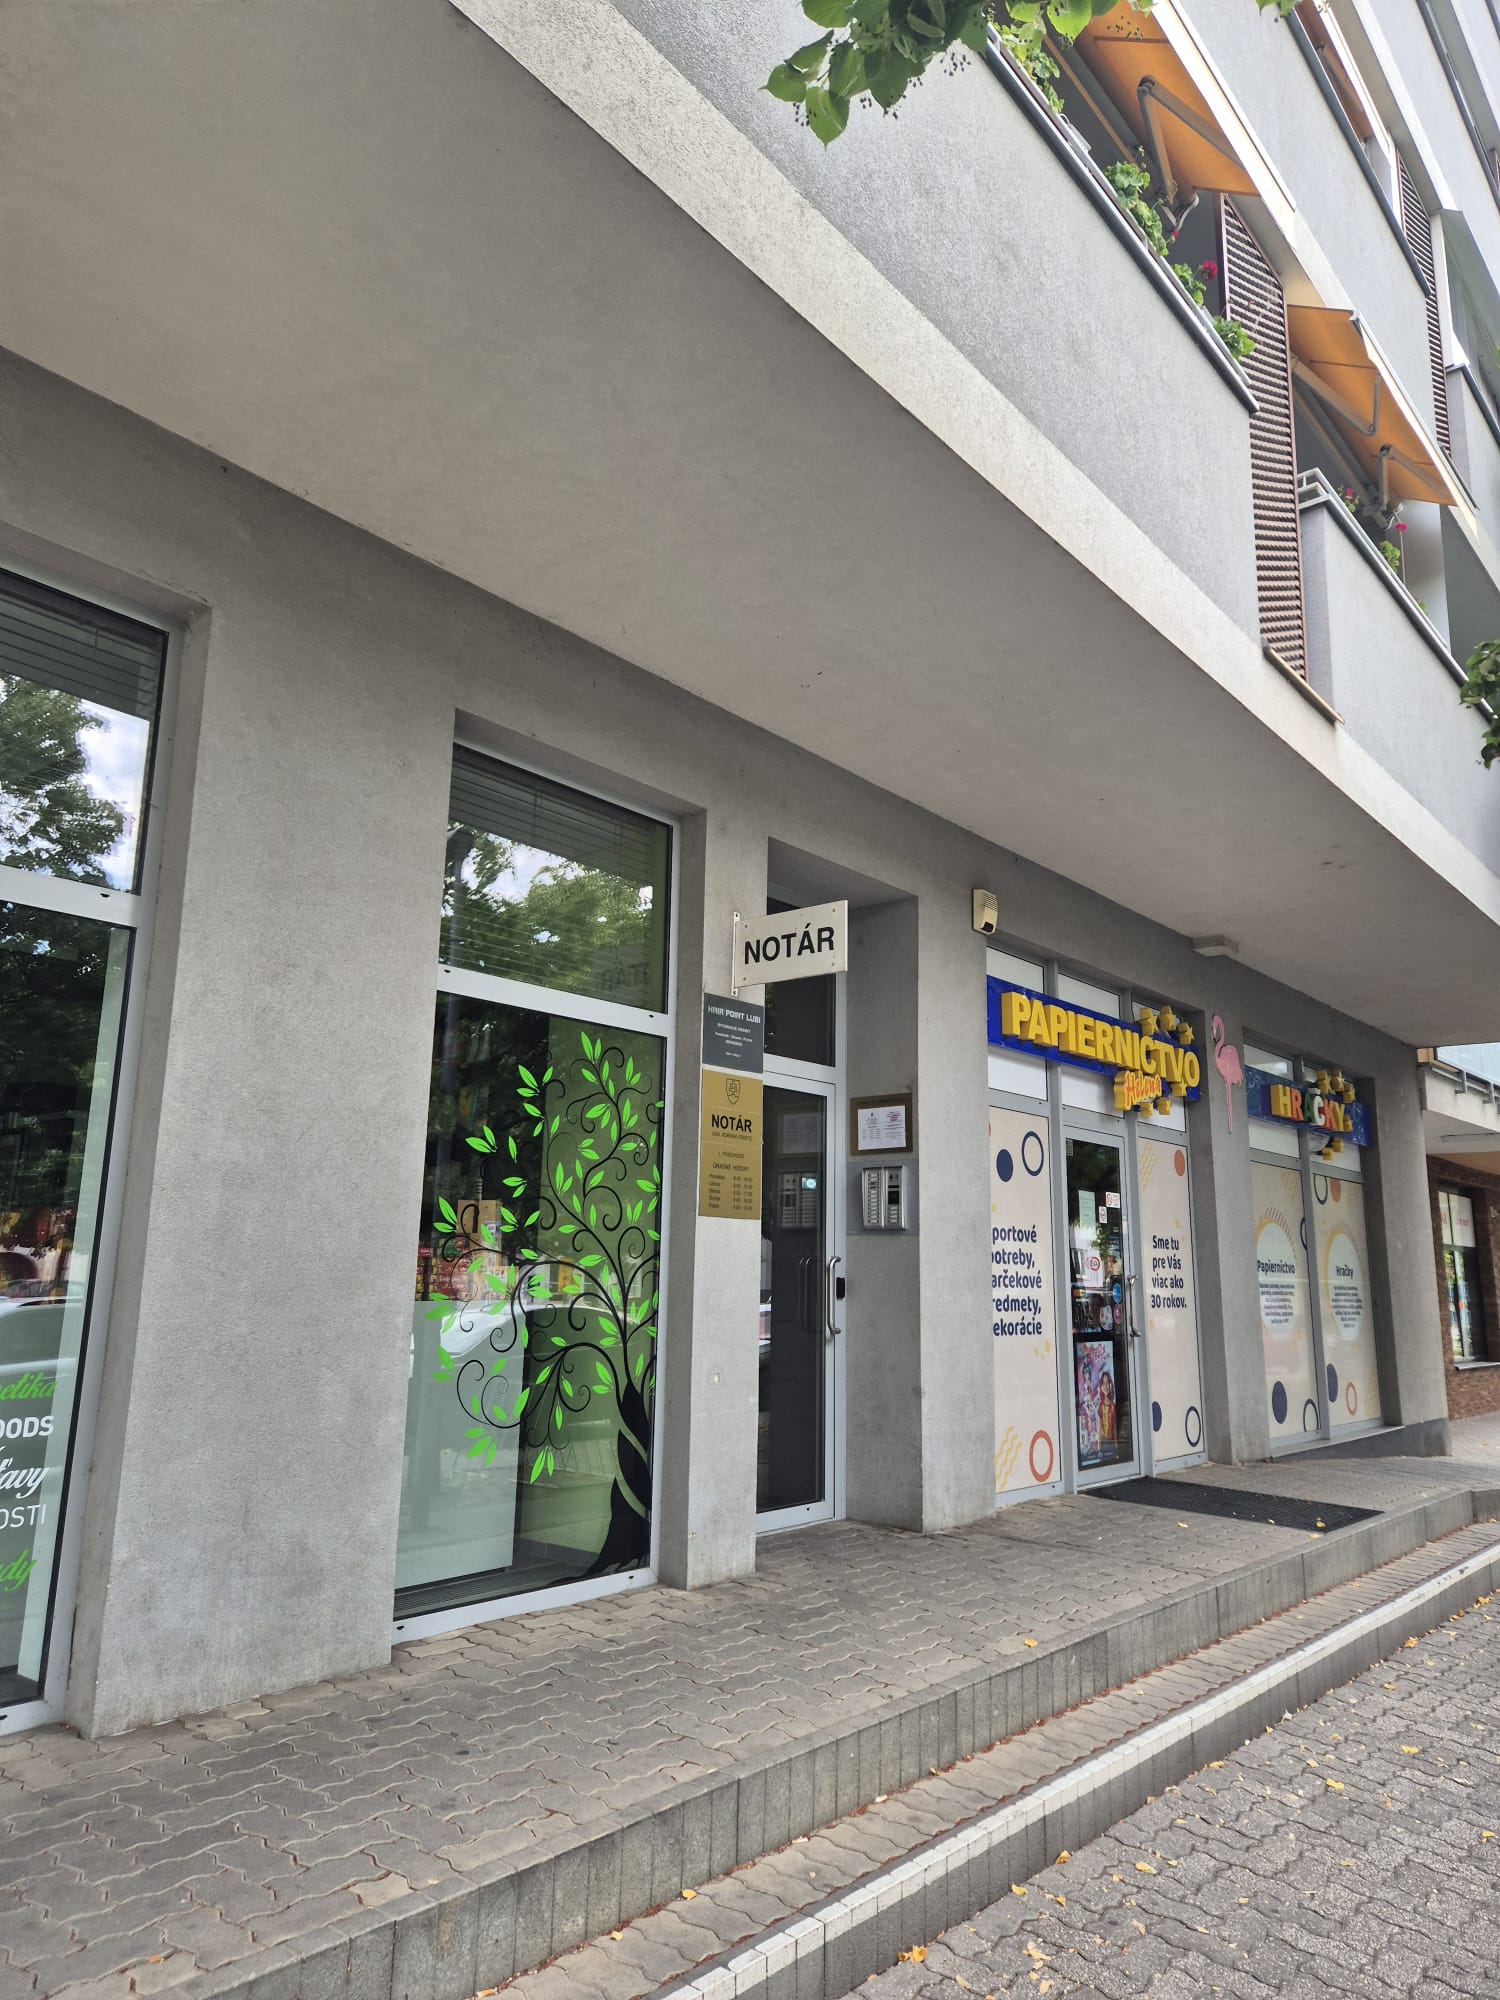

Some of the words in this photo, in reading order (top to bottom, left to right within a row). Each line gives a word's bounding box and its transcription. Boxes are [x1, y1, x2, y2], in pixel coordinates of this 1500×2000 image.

[744, 922, 835, 965] NOTÁR
[725, 1009, 745, 1020] POINT
[1002, 991, 1200, 1088] PAPIERNICTVO
[1121, 1069, 1162, 1111] Helena
[1270, 1082, 1345, 1132] HRAČKY
[711, 1113, 752, 1133] NOTÁR
[1152, 1234, 1169, 1250] Sme
[1170, 1237, 1179, 1250] tu
[1152, 1257, 1166, 1272] pre
[1166, 1254, 1181, 1270] Vás
[1256, 1260, 1296, 1276] Papiernictvo
[1335, 1264, 1353, 1279] Hračky
[1152, 1273, 1168, 1288] viac
[1170, 1275, 1184, 1289] ako
[1151, 1294, 1161, 1309] 30
[1163, 1294, 1187, 1309] rokov.
[0, 1371, 57, 1400] etika
